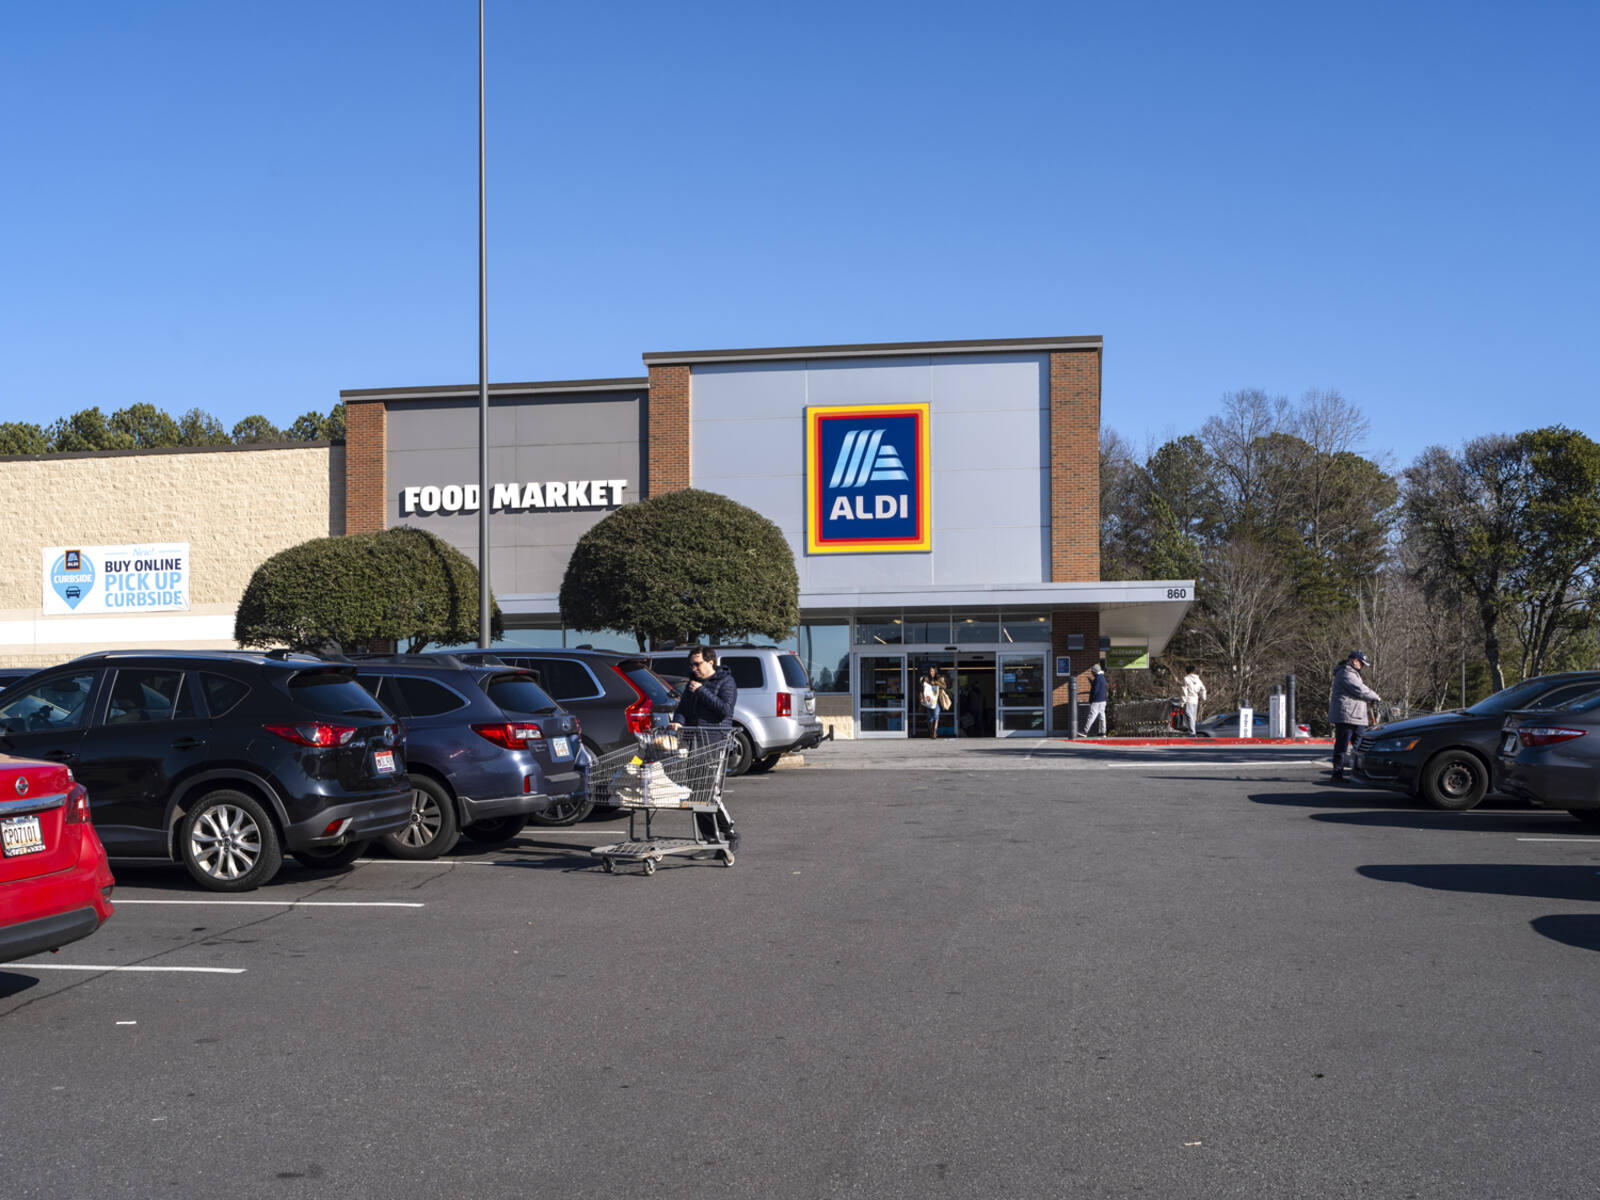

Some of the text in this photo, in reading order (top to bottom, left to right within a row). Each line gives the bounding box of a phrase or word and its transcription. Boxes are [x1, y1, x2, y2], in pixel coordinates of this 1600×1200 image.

[404, 479, 628, 513] FOOD MARKET
[829, 494, 908, 520] ALDI
[104, 558, 182, 573] BUY ONLINE
[53, 574, 92, 584] CURBSIDE
[104, 571, 182, 591] PICK UP
[104, 590, 183, 607] CURBSIDE
[1167, 588, 1187, 599] 860
